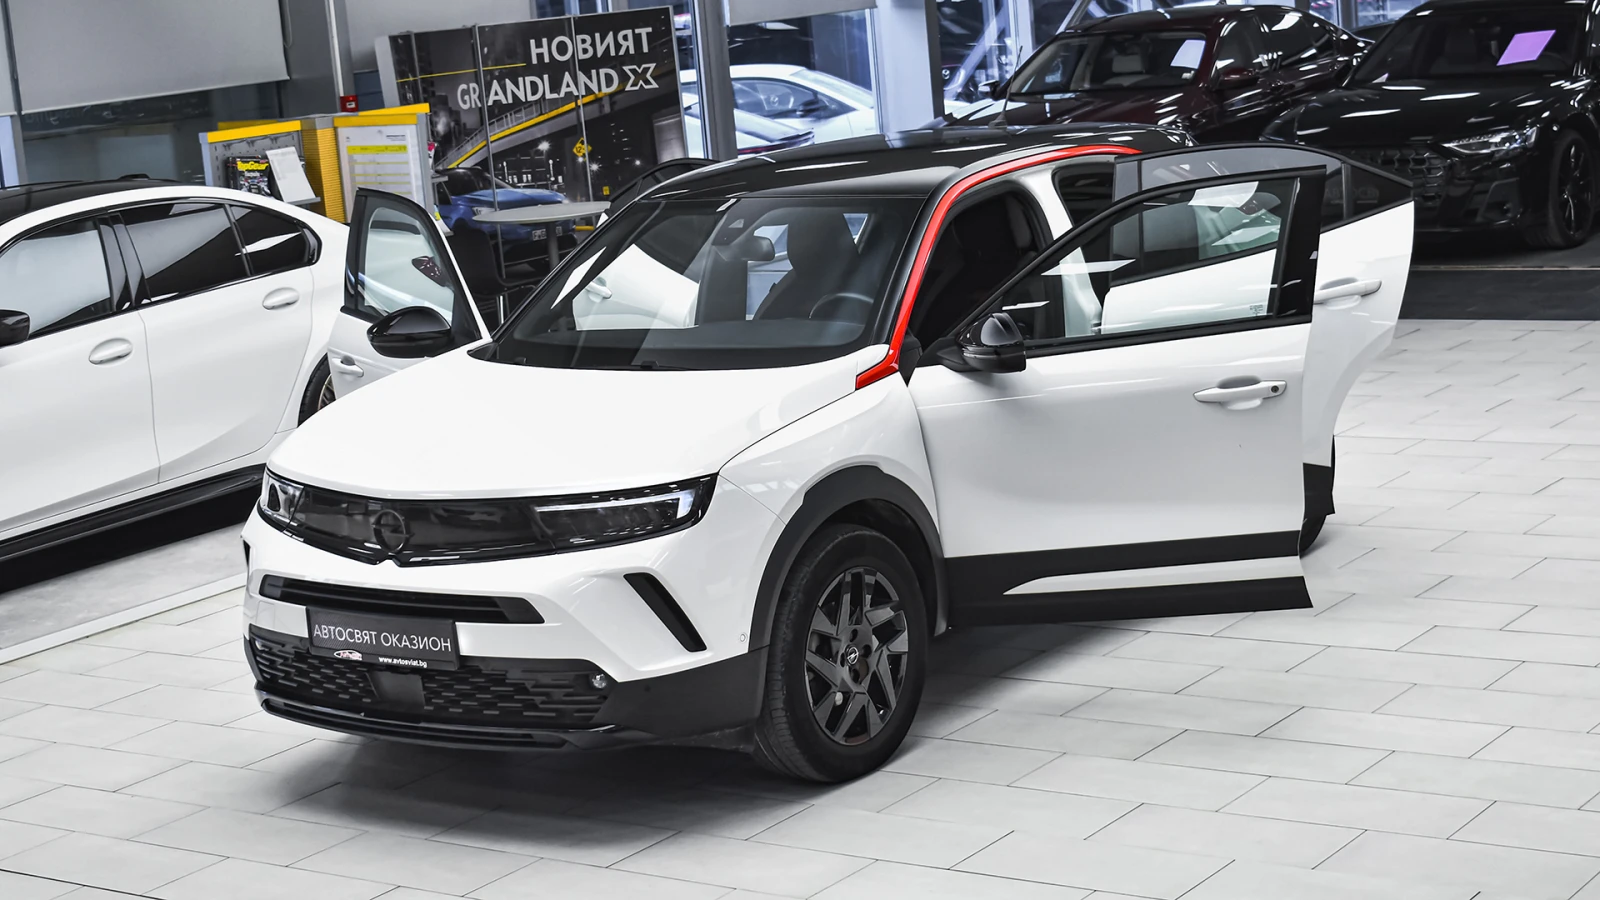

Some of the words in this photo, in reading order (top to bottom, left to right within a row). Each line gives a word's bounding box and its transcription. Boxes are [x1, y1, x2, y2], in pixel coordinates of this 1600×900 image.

[530, 27, 652, 65] НОВИЯТ
[457, 68, 619, 110] GRANDLAND
[624, 63, 659, 91] X
[313, 624, 377, 645] АВТОСВЯТ
[381, 632, 452, 652] ОКАЗИОН
